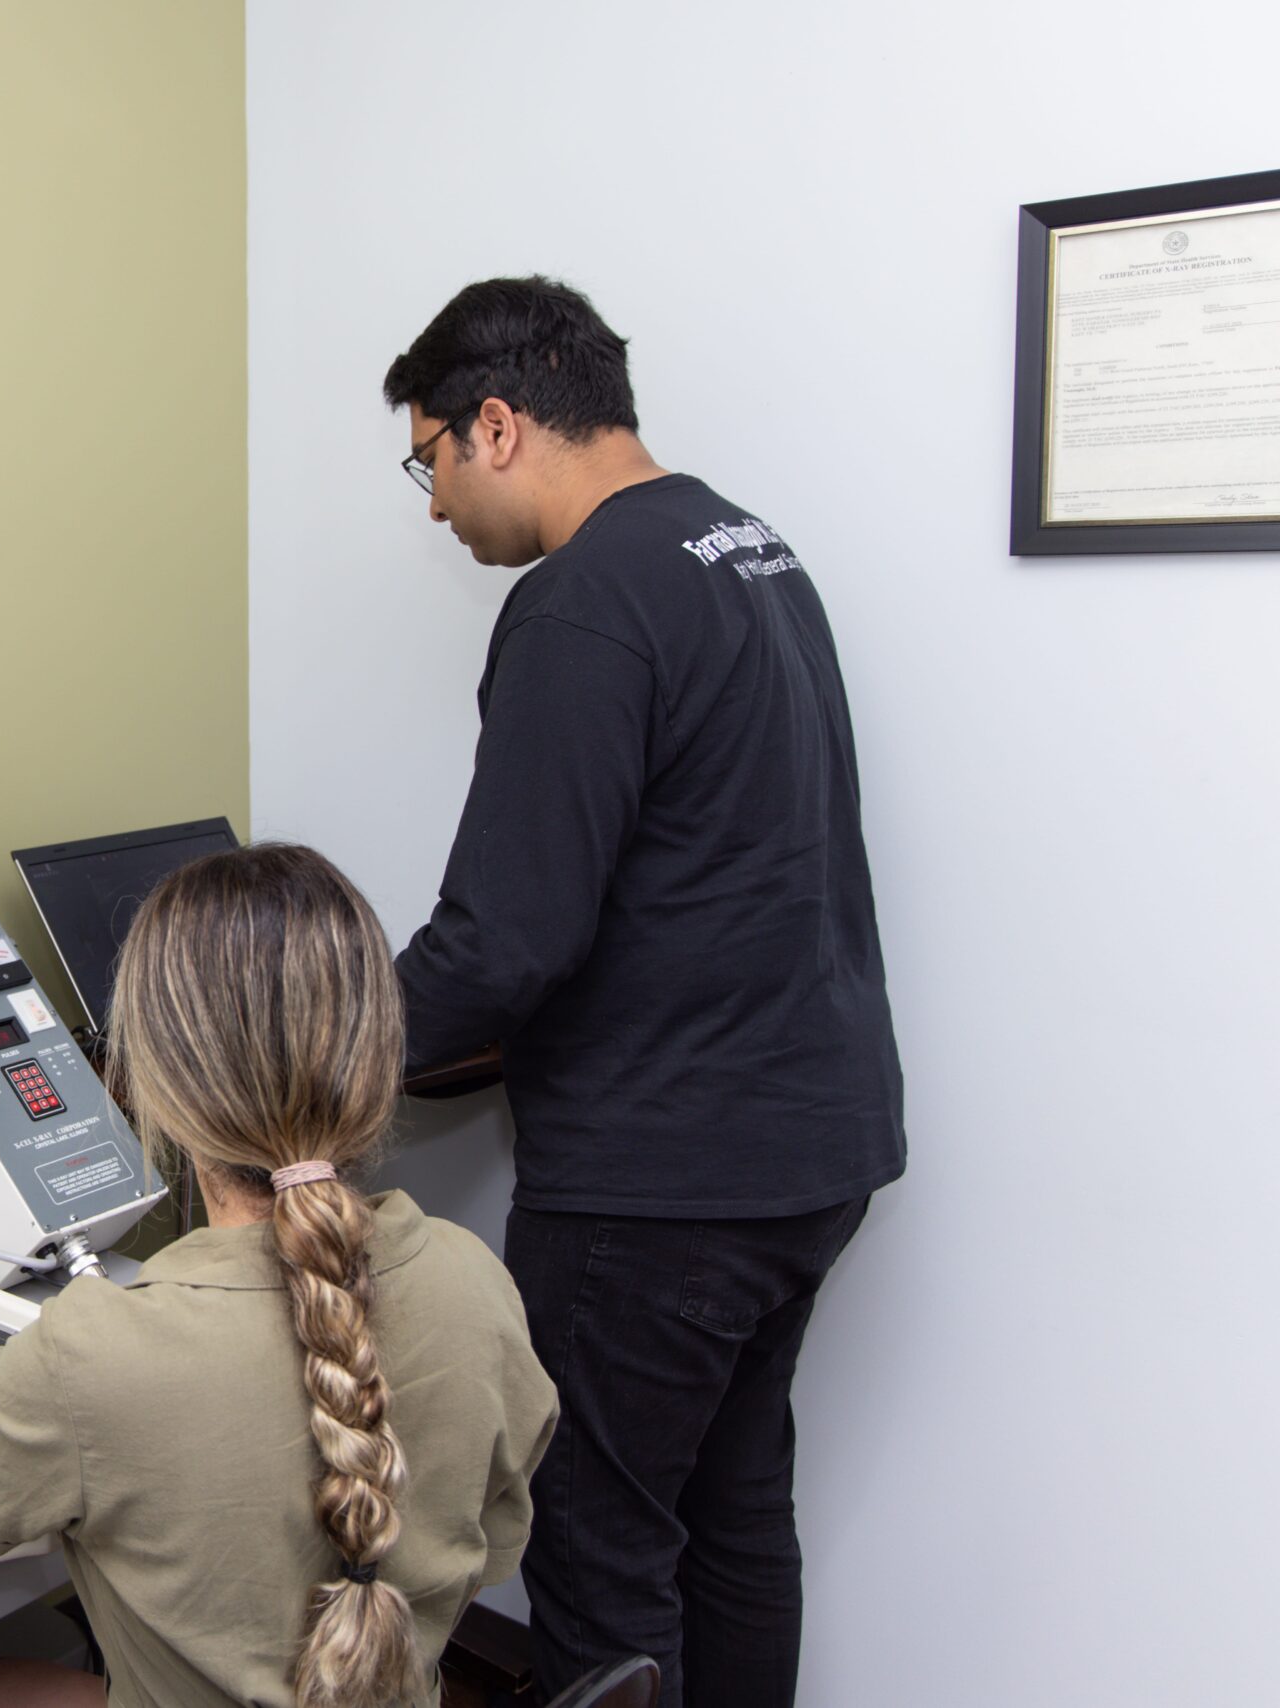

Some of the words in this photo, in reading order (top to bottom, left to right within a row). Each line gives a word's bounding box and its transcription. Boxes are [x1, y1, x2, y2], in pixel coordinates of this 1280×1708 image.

[1099, 269, 1150, 280] CERTIFICATE
[1165, 264, 1189, 272] X-RAY
[1191, 256, 1252, 269] REGISTRATION
[762, 554, 788, 575] General
[14, 1139, 32, 1149] X-CEL
[33, 1132, 53, 1142] X-RAY
[56, 1116, 100, 1134] CORPORATION
[35, 1139, 56, 1149] CRYSTAL
